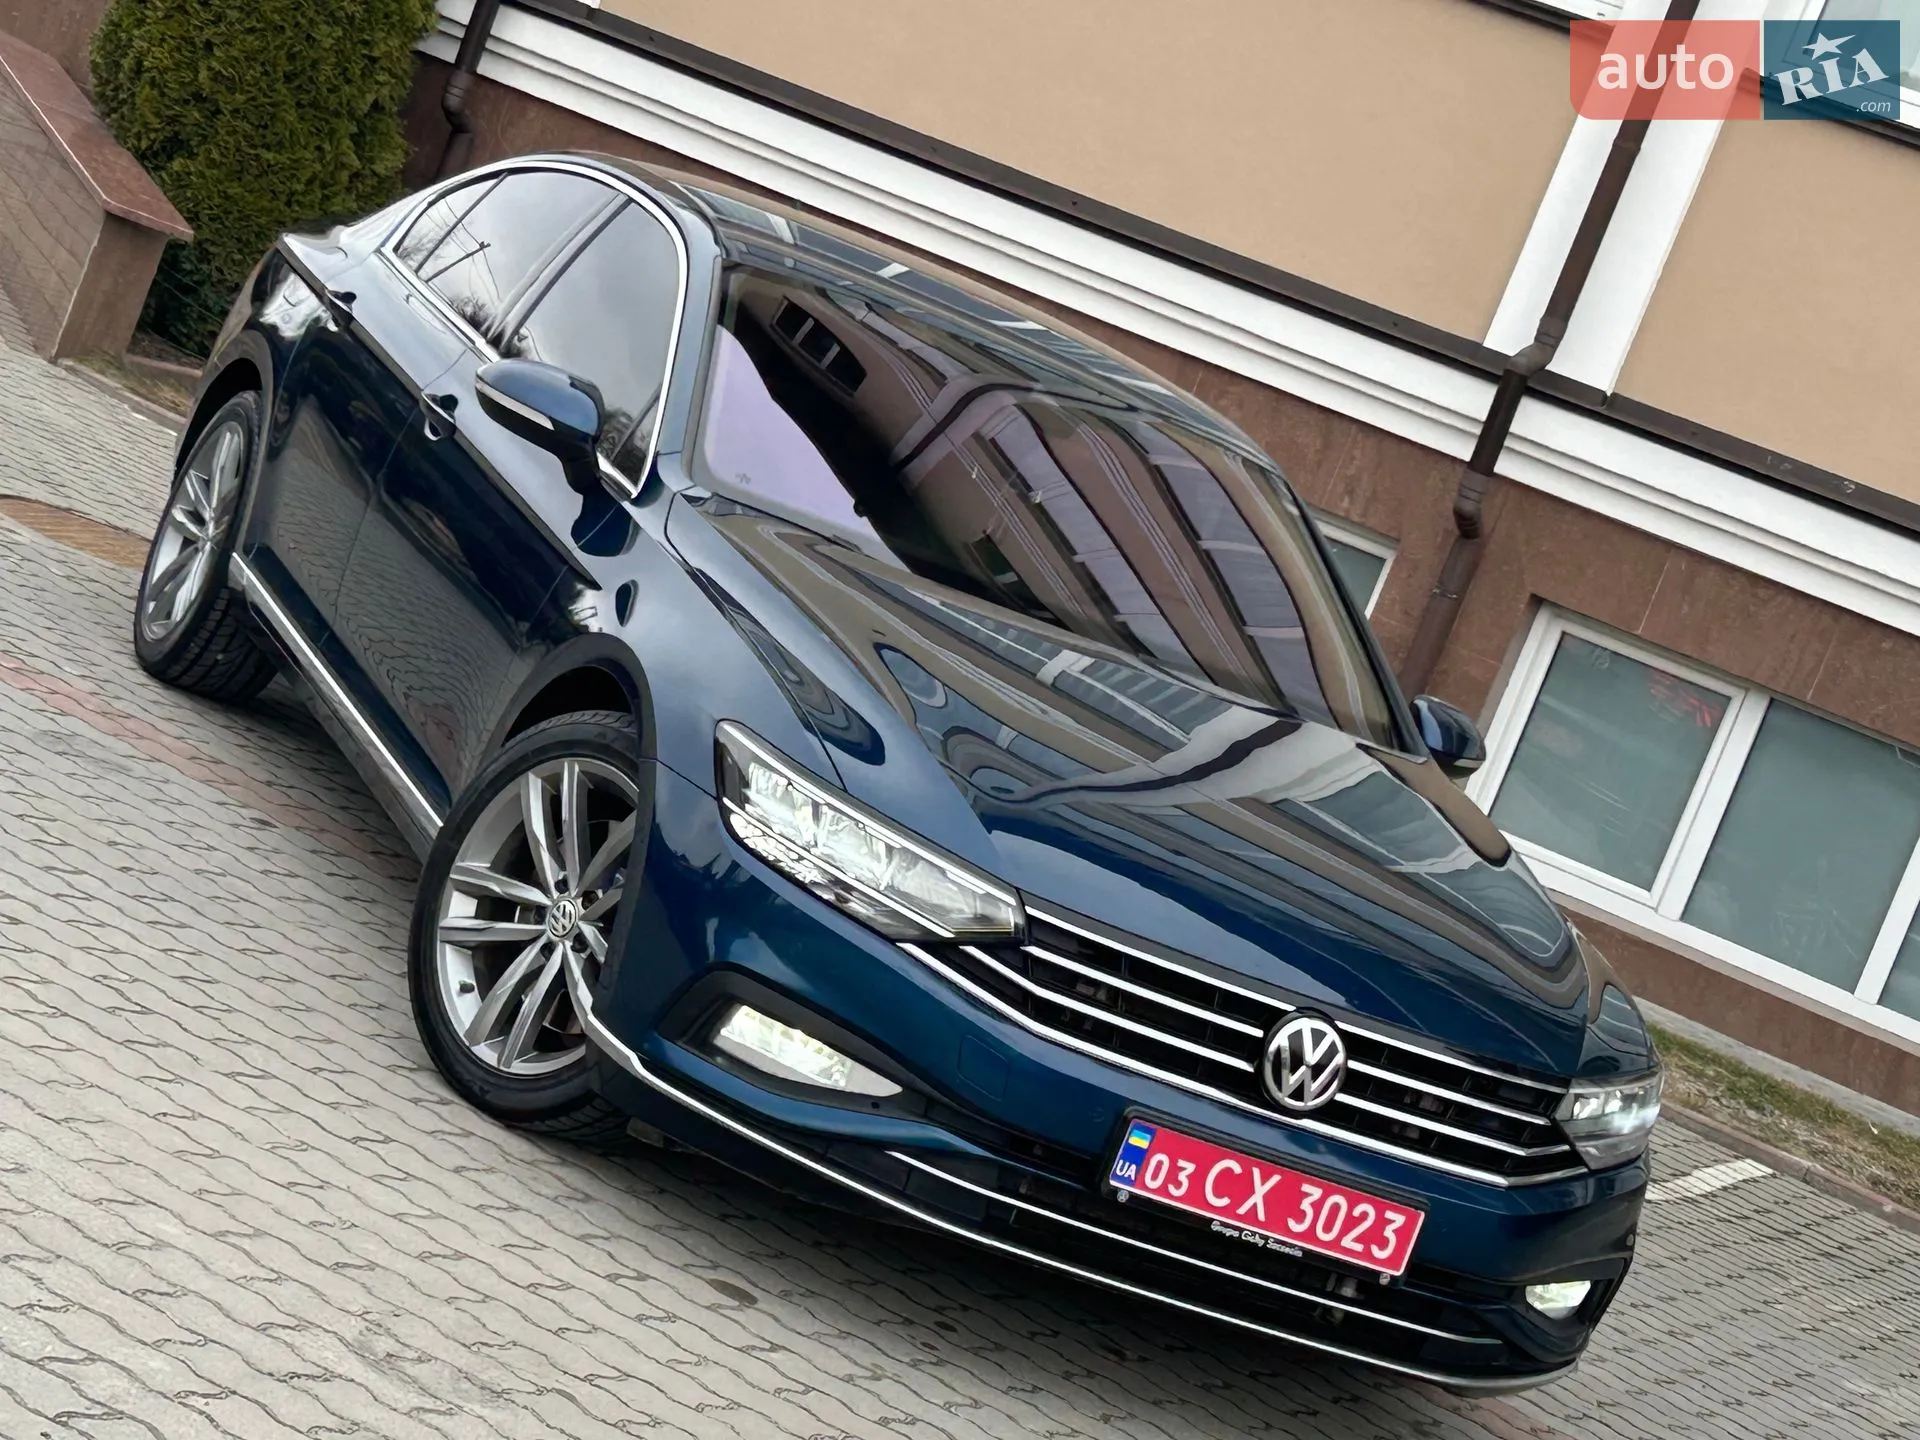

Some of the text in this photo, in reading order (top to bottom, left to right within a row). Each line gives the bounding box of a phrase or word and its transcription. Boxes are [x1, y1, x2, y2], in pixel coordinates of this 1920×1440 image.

[1264, 1018, 1346, 1110] VW
[1116, 1159, 1137, 1181] UA
[1144, 1152, 1407, 1260] 03 CX 3023
